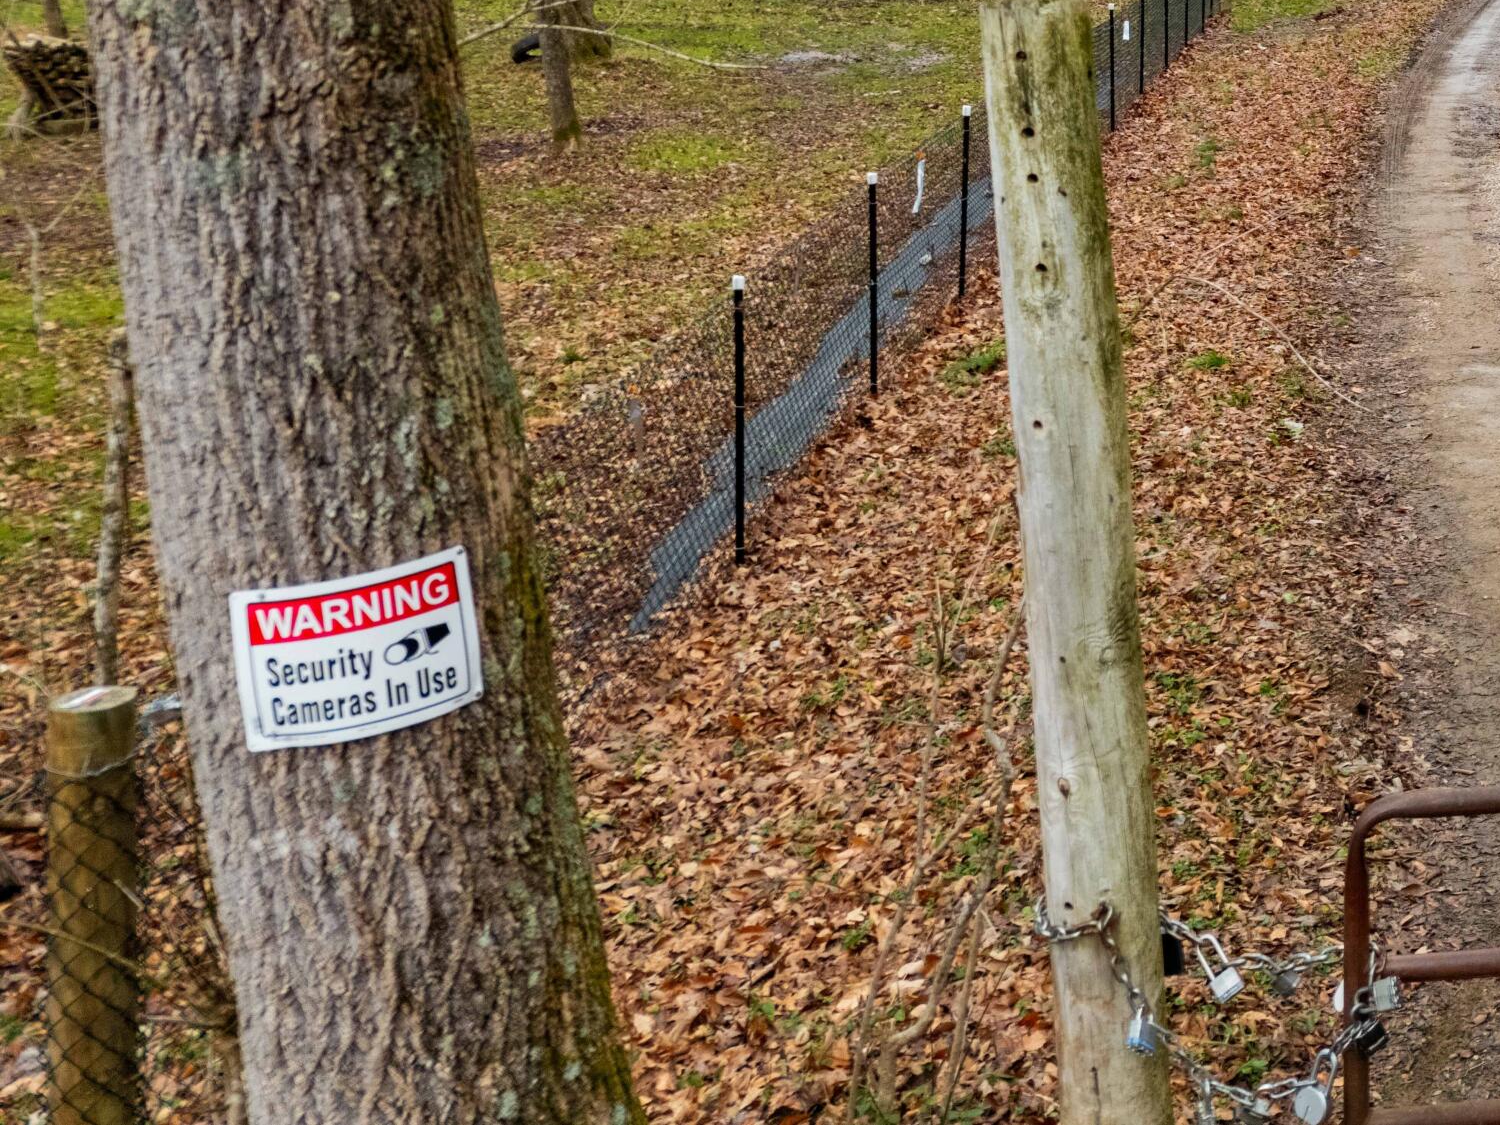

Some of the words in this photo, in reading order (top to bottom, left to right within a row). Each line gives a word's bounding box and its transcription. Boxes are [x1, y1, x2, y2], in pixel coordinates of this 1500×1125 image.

[255, 572, 450, 641] WARNING
[266, 649, 373, 688] Security
[272, 690, 376, 725] Cameras
[387, 679, 408, 707] In
[417, 666, 457, 698] Use
